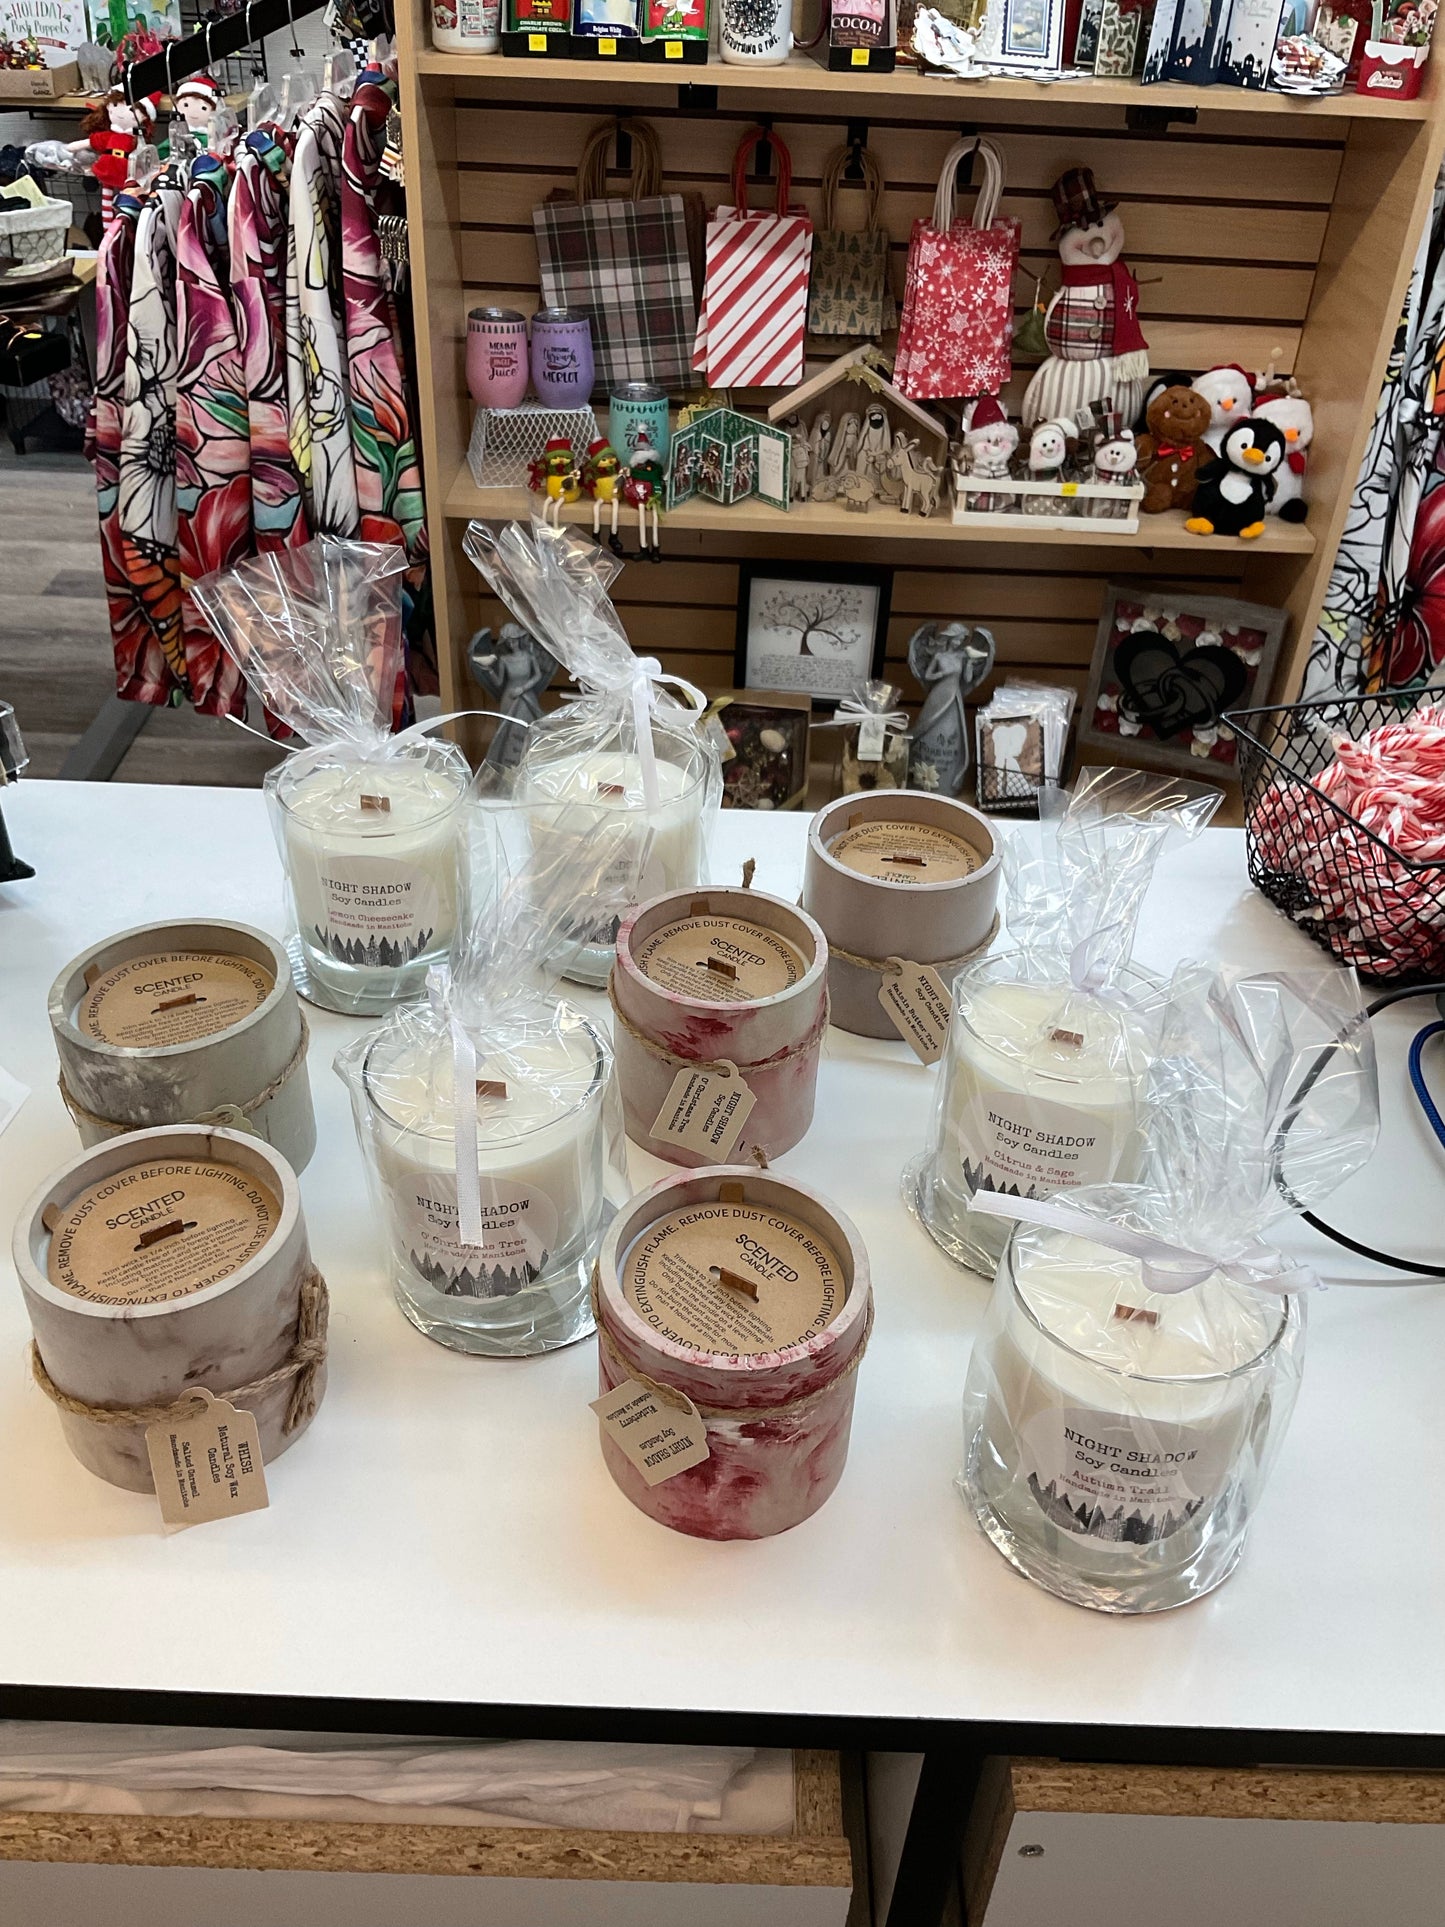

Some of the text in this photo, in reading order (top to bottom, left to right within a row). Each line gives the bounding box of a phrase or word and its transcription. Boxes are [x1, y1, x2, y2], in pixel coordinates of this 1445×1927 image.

[11, 1, 62, 20] HOLIDAY
[11, 20, 70, 37] Push Puppets
[832, 16, 882, 36] COCOA!
[886, 824, 916, 832] COVER
[321, 877, 412, 895] NIGHT SHADOW
[332, 894, 402, 906] Soy Candles
[662, 920, 790, 960] REMOVE DUST COVER BEFORE
[710, 938, 766, 966] SCENTED
[716, 950, 748, 967] CANDLE
[88, 986, 110, 1018] REMOVE
[106, 968, 130, 986] DUST
[132, 956, 168, 971] COVER
[171, 955, 214, 963] BEFORE
[134, 972, 204, 995] SCENTED
[918, 974, 940, 1002] NIGHT
[915, 988, 945, 1031] Soy Candles
[908, 1008, 926, 1032] Butter
[926, 1032, 938, 1050] Tart
[702, 1107, 720, 1132] Candles
[710, 1091, 742, 1144] NIGHT SHADOW
[988, 1111, 1096, 1148] NIGHT SHADOW
[996, 1131, 1079, 1160] Soy Candles
[994, 1150, 1032, 1170] Citrus
[1046, 1168, 1075, 1179] Sage
[106, 1190, 185, 1230] SCENTED
[130, 1206, 174, 1229] CANDLE
[428, 1214, 451, 1229] Soy
[480, 1200, 530, 1217] HADOW
[678, 1208, 729, 1227] REMOVE
[732, 1209, 766, 1222] DUST
[58, 1166, 269, 1305] REMOVE DUST COVER BEFORE LIGHTING. DO NOT USE DUST COVER TO EXTINGUISH FLAME.
[498, 1238, 528, 1248] Tree
[644, 1225, 679, 1254] FLAME.
[768, 1218, 804, 1242] COVER
[736, 1234, 798, 1282] SCENTED
[740, 1252, 776, 1281] CANDLE
[802, 1240, 832, 1277] BEFORE
[634, 1254, 654, 1314] EXTINGUISH
[685, 1280, 709, 1301] matches
[708, 1300, 721, 1310] and
[676, 1282, 719, 1319] burn candle
[676, 1264, 696, 1280] candle
[695, 1279, 708, 1290] free
[714, 1295, 726, 1304] any
[726, 1302, 747, 1320] foreign
[746, 1320, 774, 1343] materials
[717, 1288, 730, 1299] inch
[729, 1298, 749, 1314] before
[812, 1278, 835, 1327] LIGHTING.
[648, 1314, 664, 1330] TO
[692, 1314, 738, 1350] candle more
[238, 1440, 254, 1475] WHISH
[644, 1436, 694, 1468] NIGHT SHADOW
[1064, 1426, 1198, 1464] NIGHT SHADOW
[182, 1441, 200, 1498] Salted Caramel
[208, 1448, 220, 1484] Candles
[218, 1425, 238, 1498] Natural Soy Wax
[1074, 1450, 1178, 1478] Soy Candles
[1072, 1470, 1125, 1493] Autumn
